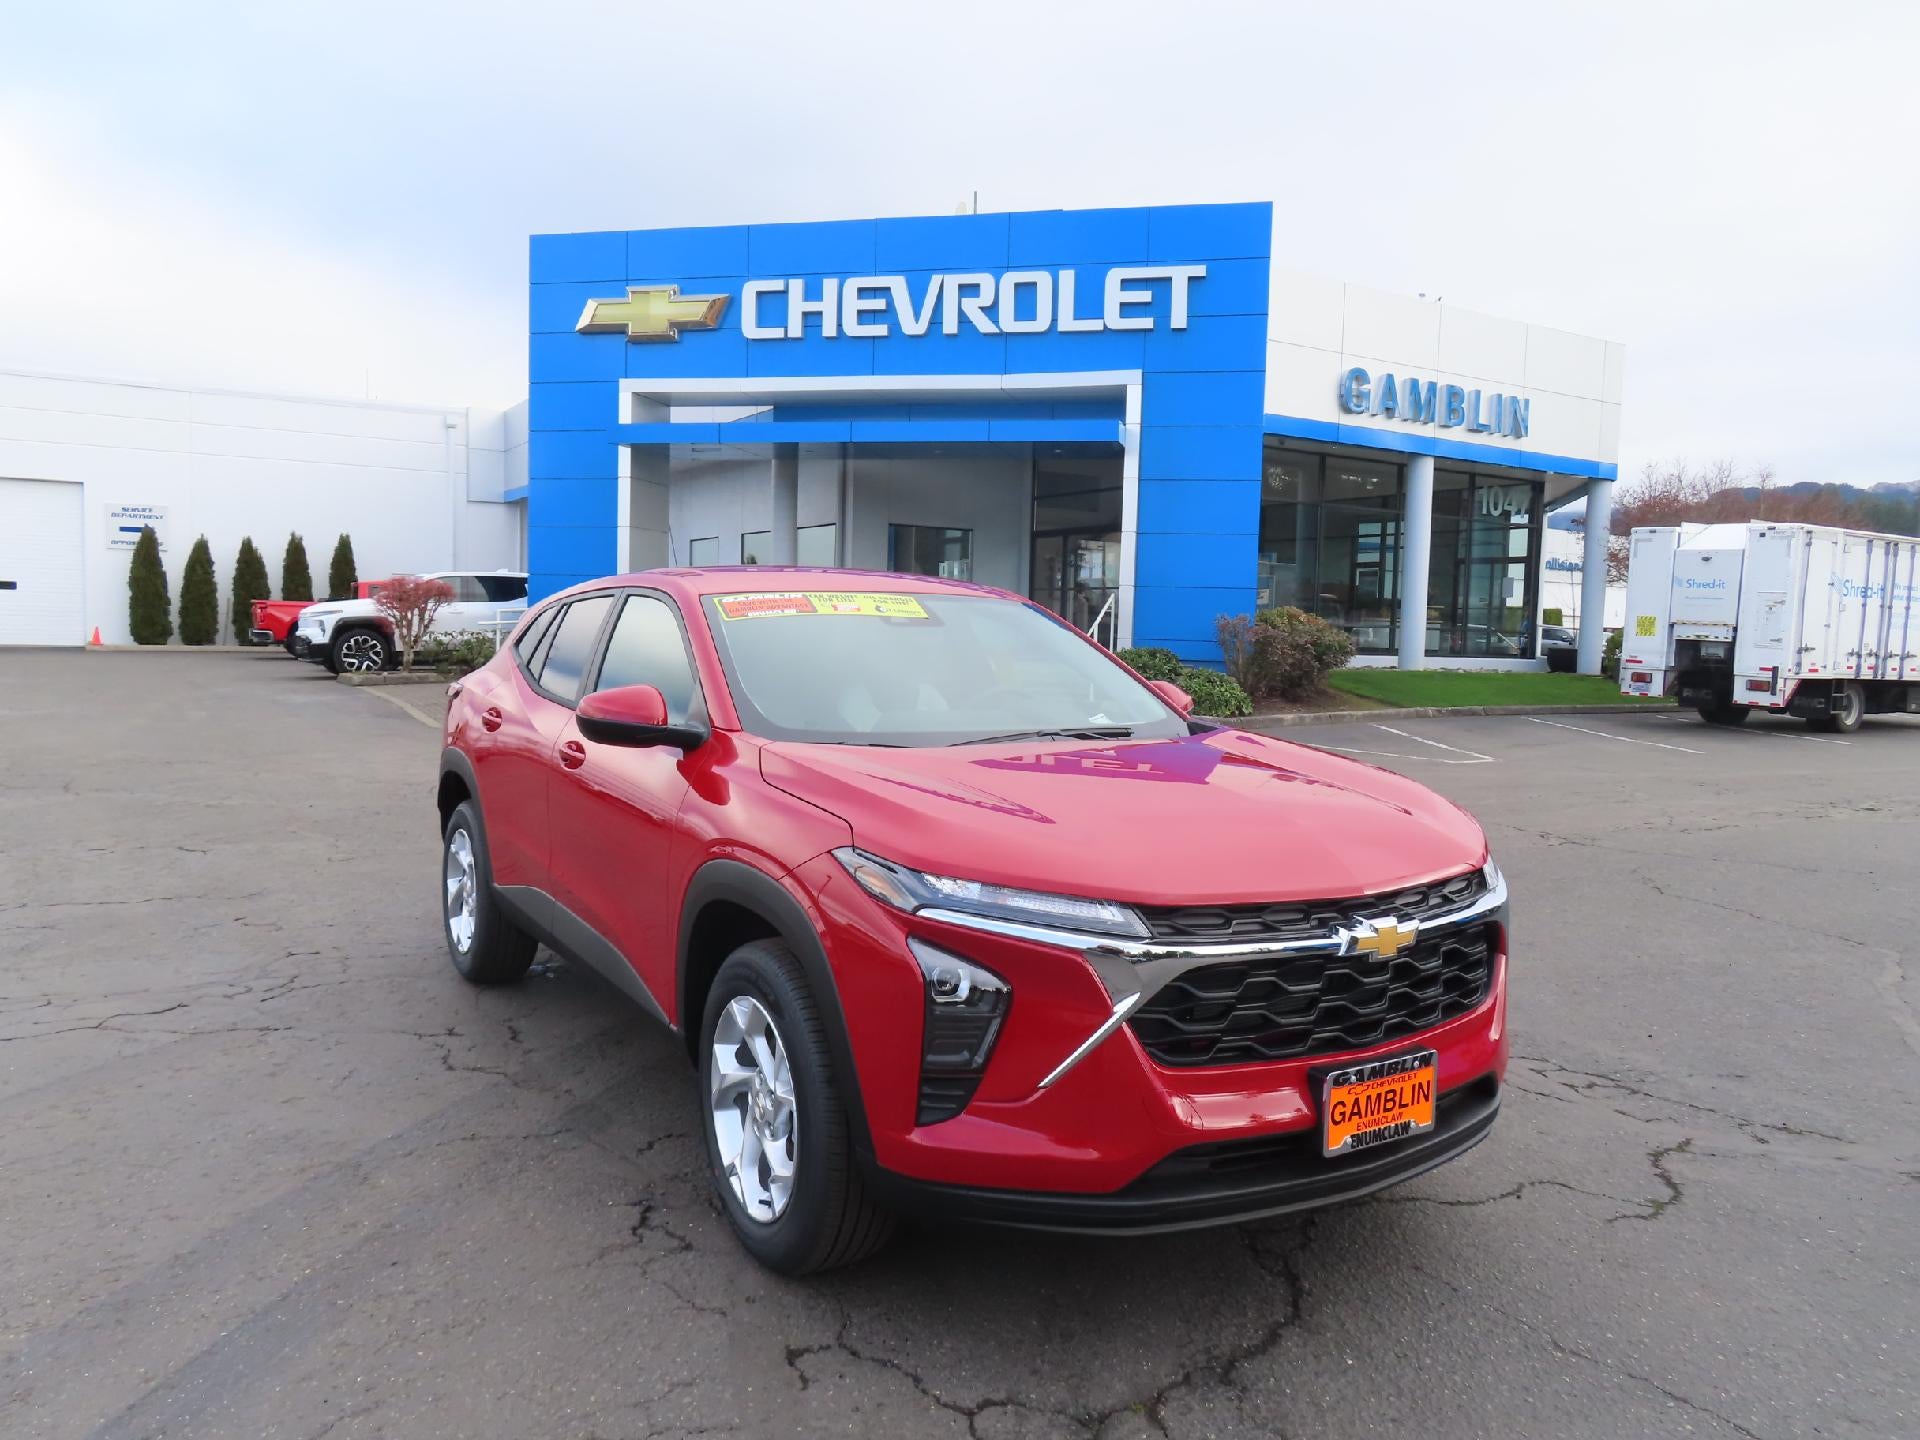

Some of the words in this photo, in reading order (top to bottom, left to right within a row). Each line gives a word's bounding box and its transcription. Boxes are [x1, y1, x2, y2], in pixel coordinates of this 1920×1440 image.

[742, 264, 1207, 341] CHEVROLET
[1339, 367, 1531, 440] GAMBLIN
[110, 512, 164, 520] DEPARTMENT
[1545, 556, 1580, 572] ollision
[1686, 578, 1726, 590] Shred-it
[1842, 579, 1885, 599] Shred-it
[1332, 1052, 1434, 1086] GAMBLIN
[1370, 1072, 1418, 1090] CHEVROLET
[1330, 1080, 1431, 1126] GAMBLIN
[1356, 1112, 1404, 1132] ENUMCLAW
[1350, 1120, 1412, 1150] ENUMCLAW
